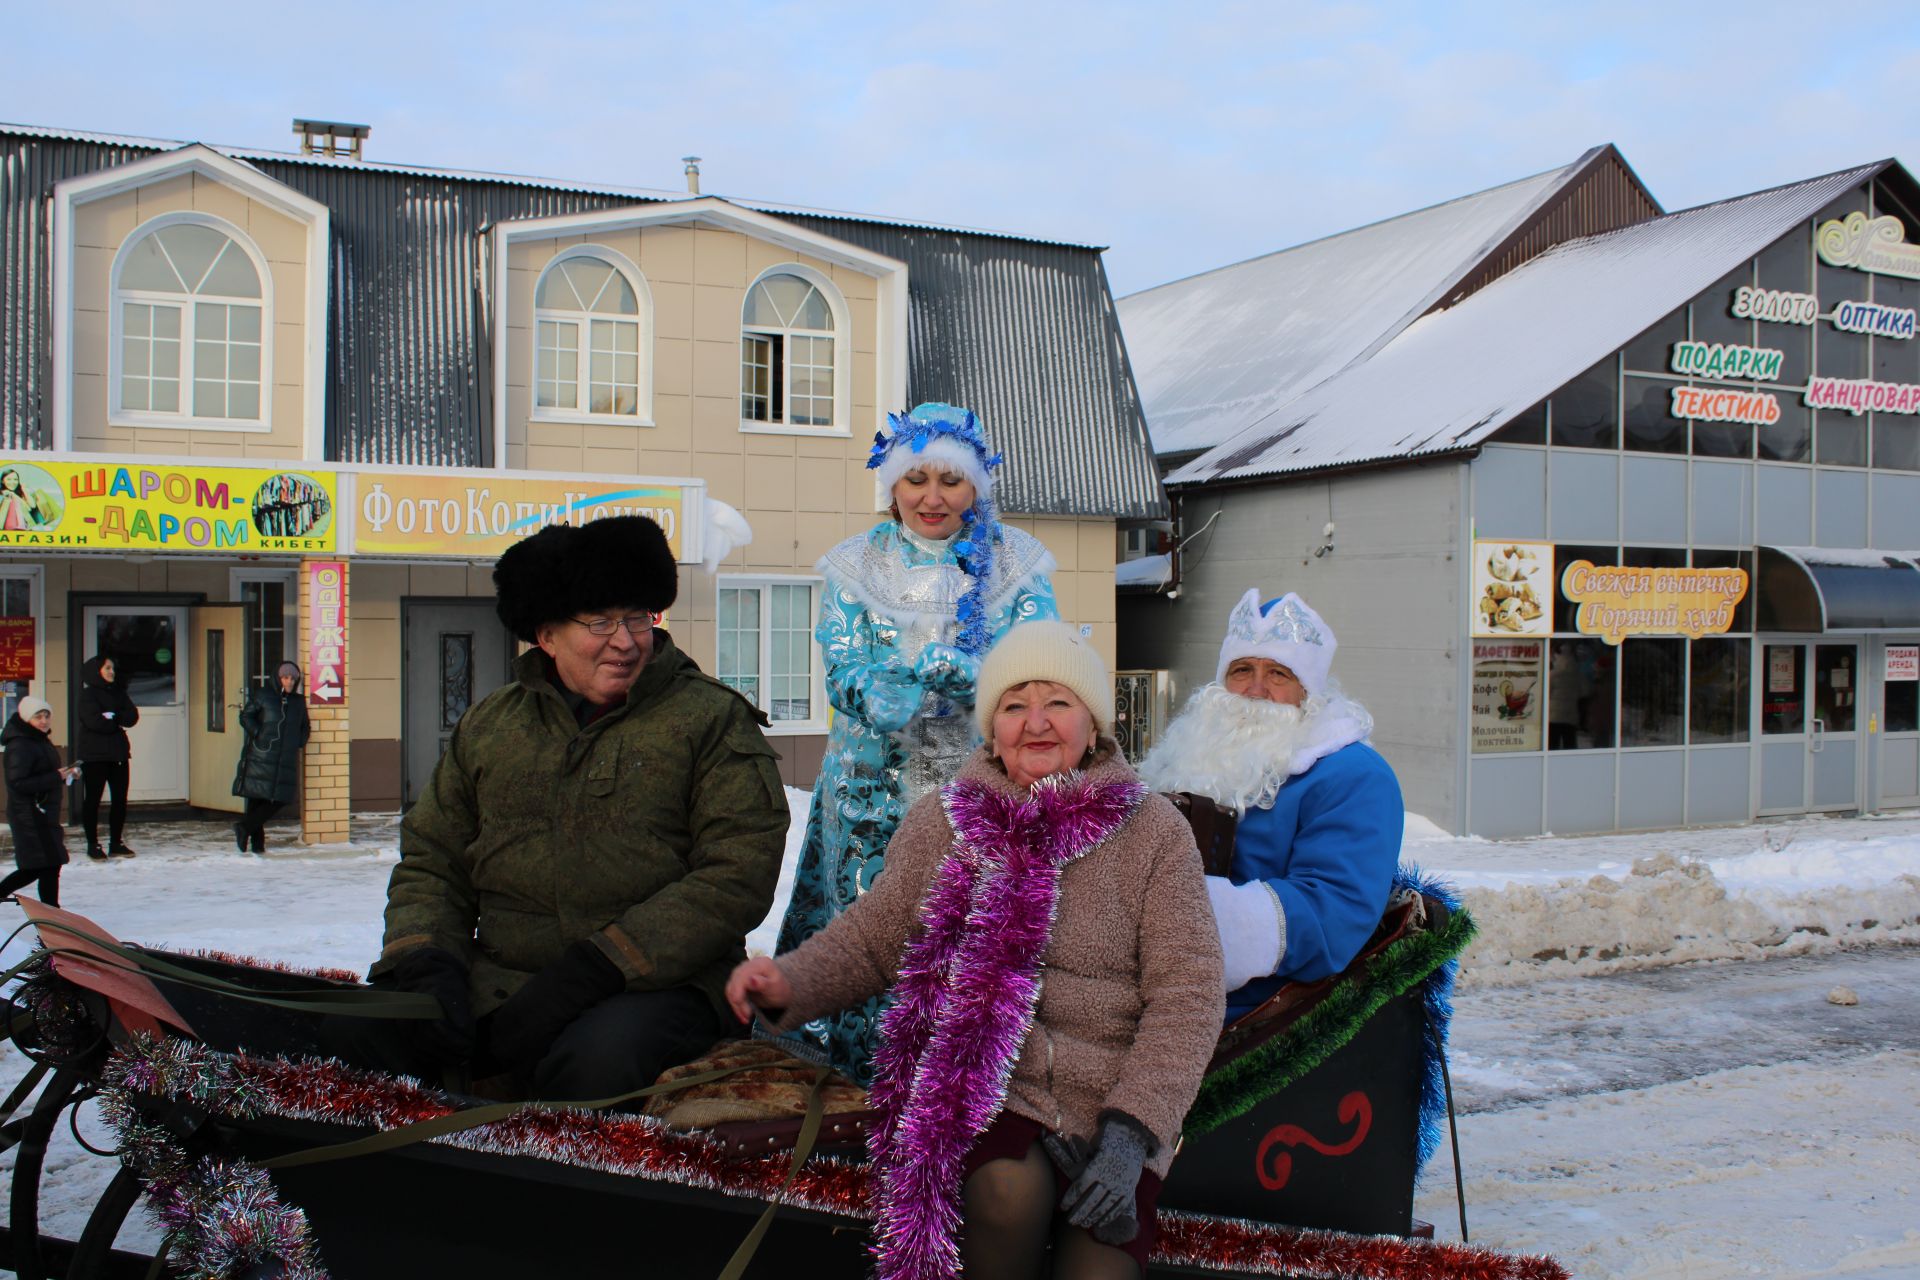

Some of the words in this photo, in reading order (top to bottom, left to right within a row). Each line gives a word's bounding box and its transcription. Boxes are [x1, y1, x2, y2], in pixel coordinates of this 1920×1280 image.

[1736, 290, 1817, 321] ЗОЛОТО
[1839, 303, 1914, 336] ОПТИКА
[1677, 345, 1782, 377] ПОДАРКИ
[1676, 389, 1779, 422] ТЕКСТИЛЬ
[1809, 380, 1920, 411] КАНЦТОВАР
[69, 467, 246, 511] ШАРОМ-
[83, 504, 249, 548] -ДАРОМ
[260, 539, 328, 550] КИБЕТ
[1570, 568, 1650, 599] Свежая
[1655, 574, 1742, 601] выпечка
[314, 568, 344, 684] ОДЕЖДА
[1587, 602, 1679, 637] Горячий
[1682, 600, 1732, 634] хлеб
[1473, 643, 1540, 659] КАФЕТЕРИЙ
[1473, 684, 1498, 696] Кофе
[1473, 704, 1490, 715] Чай
[1472, 724, 1525, 736] Молочный
[1477, 735, 1525, 747] коктейль
